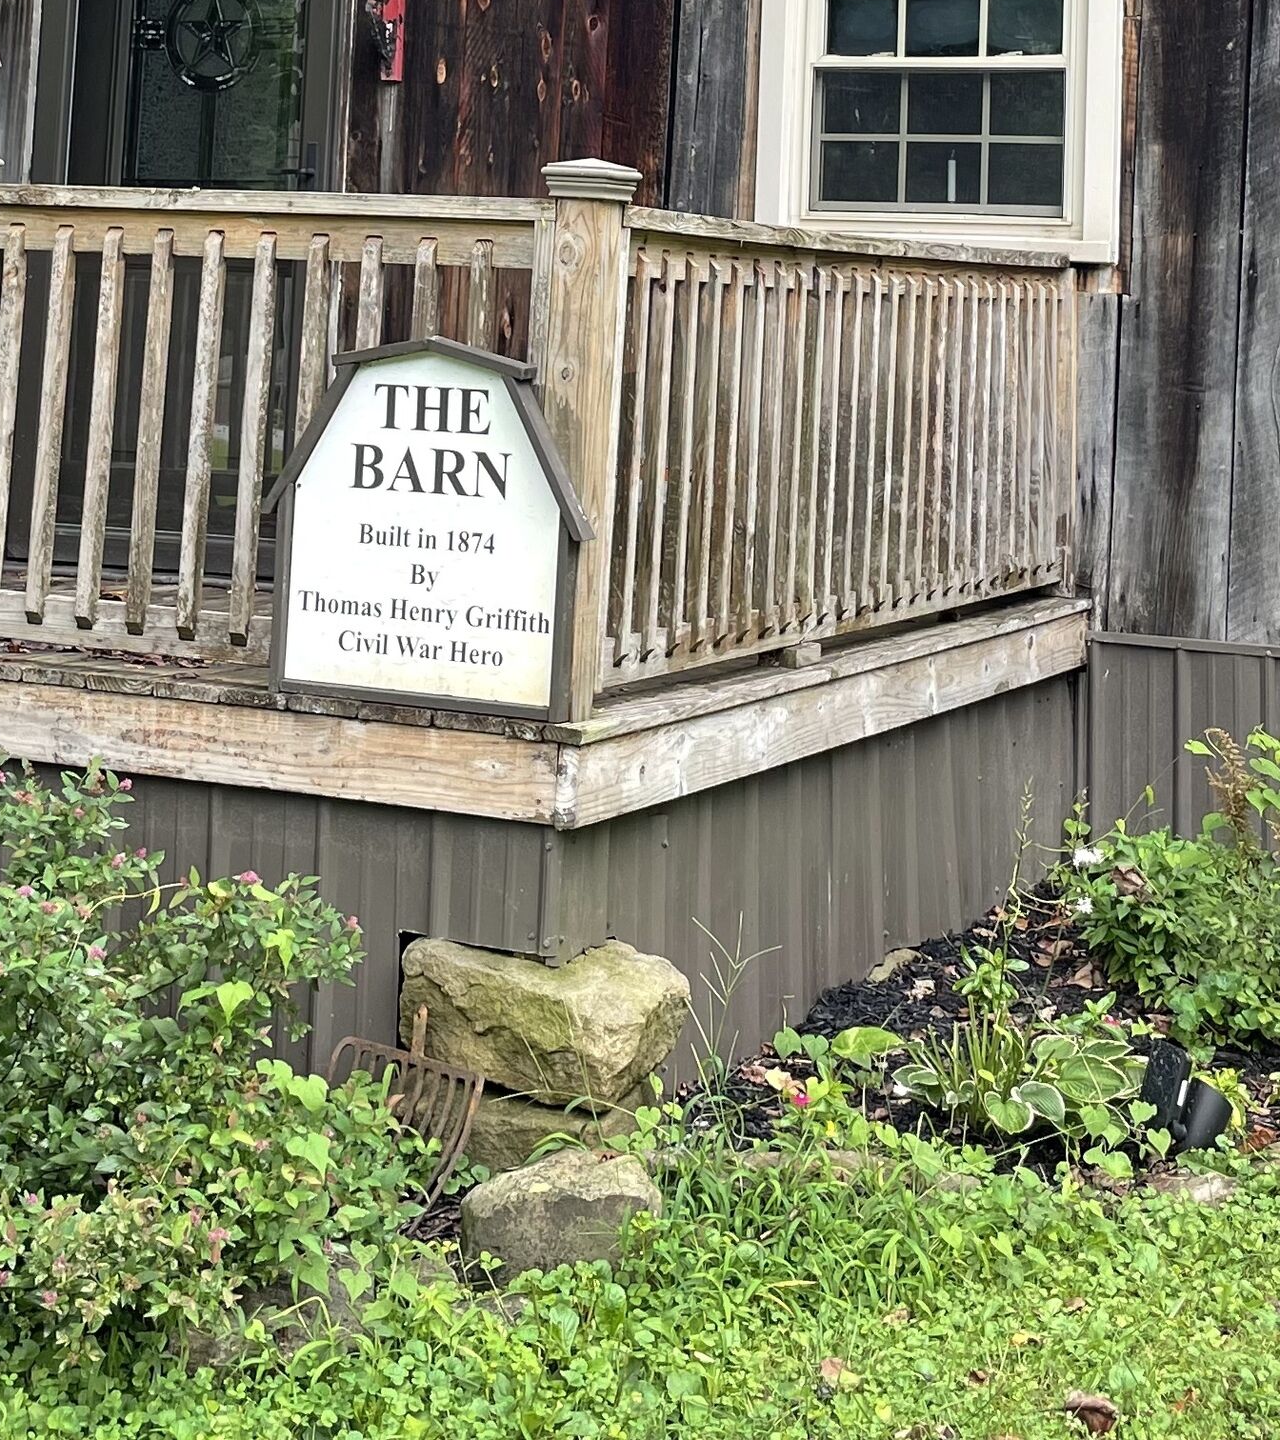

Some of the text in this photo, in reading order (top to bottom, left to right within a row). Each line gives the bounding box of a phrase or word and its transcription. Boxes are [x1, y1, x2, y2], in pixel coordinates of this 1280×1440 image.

[374, 383, 491, 436] THE
[350, 442, 512, 500] BARN
[359, 523, 495, 555] Built in 1874
[410, 563, 439, 591] By
[298, 590, 550, 634] Thomas Henry Griffith
[338, 630, 503, 667] Civil War Hero
